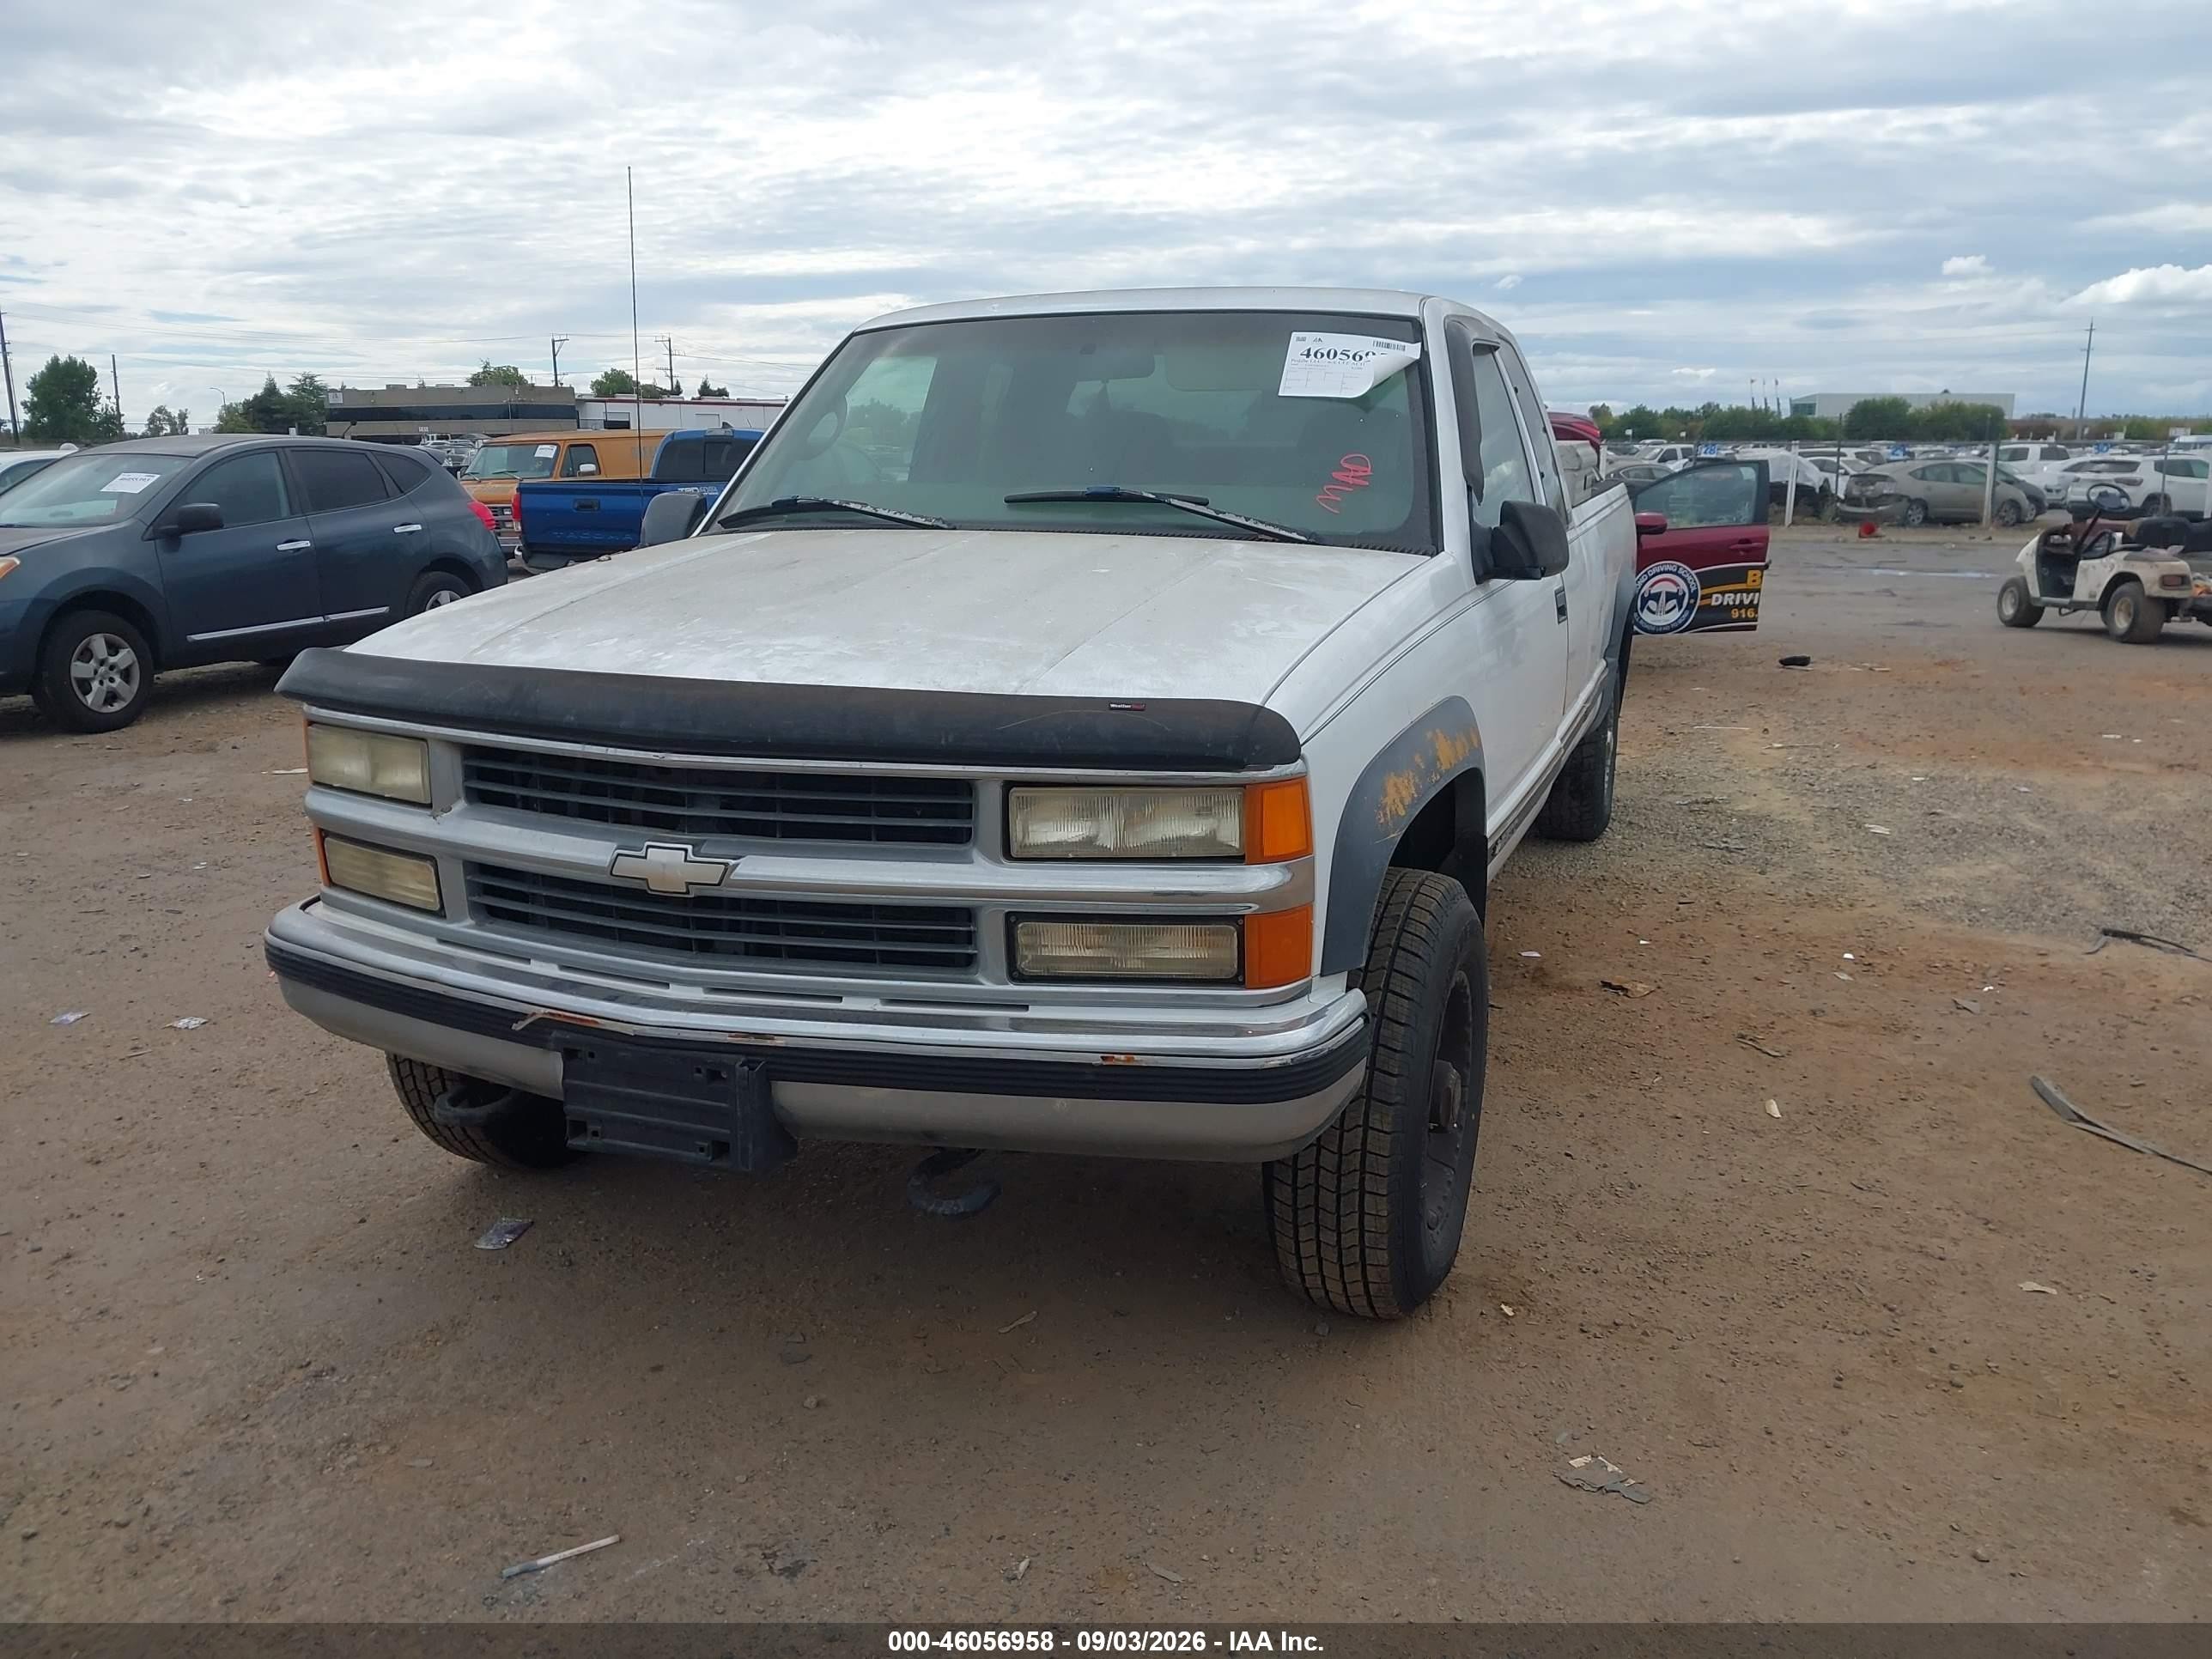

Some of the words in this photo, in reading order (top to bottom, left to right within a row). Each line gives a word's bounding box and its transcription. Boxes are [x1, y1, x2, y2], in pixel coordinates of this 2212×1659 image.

[1299, 347, 1388, 362] 46056
[1648, 564, 1678, 575] DRIVING
[1677, 567, 1698, 593] SCHOOL
